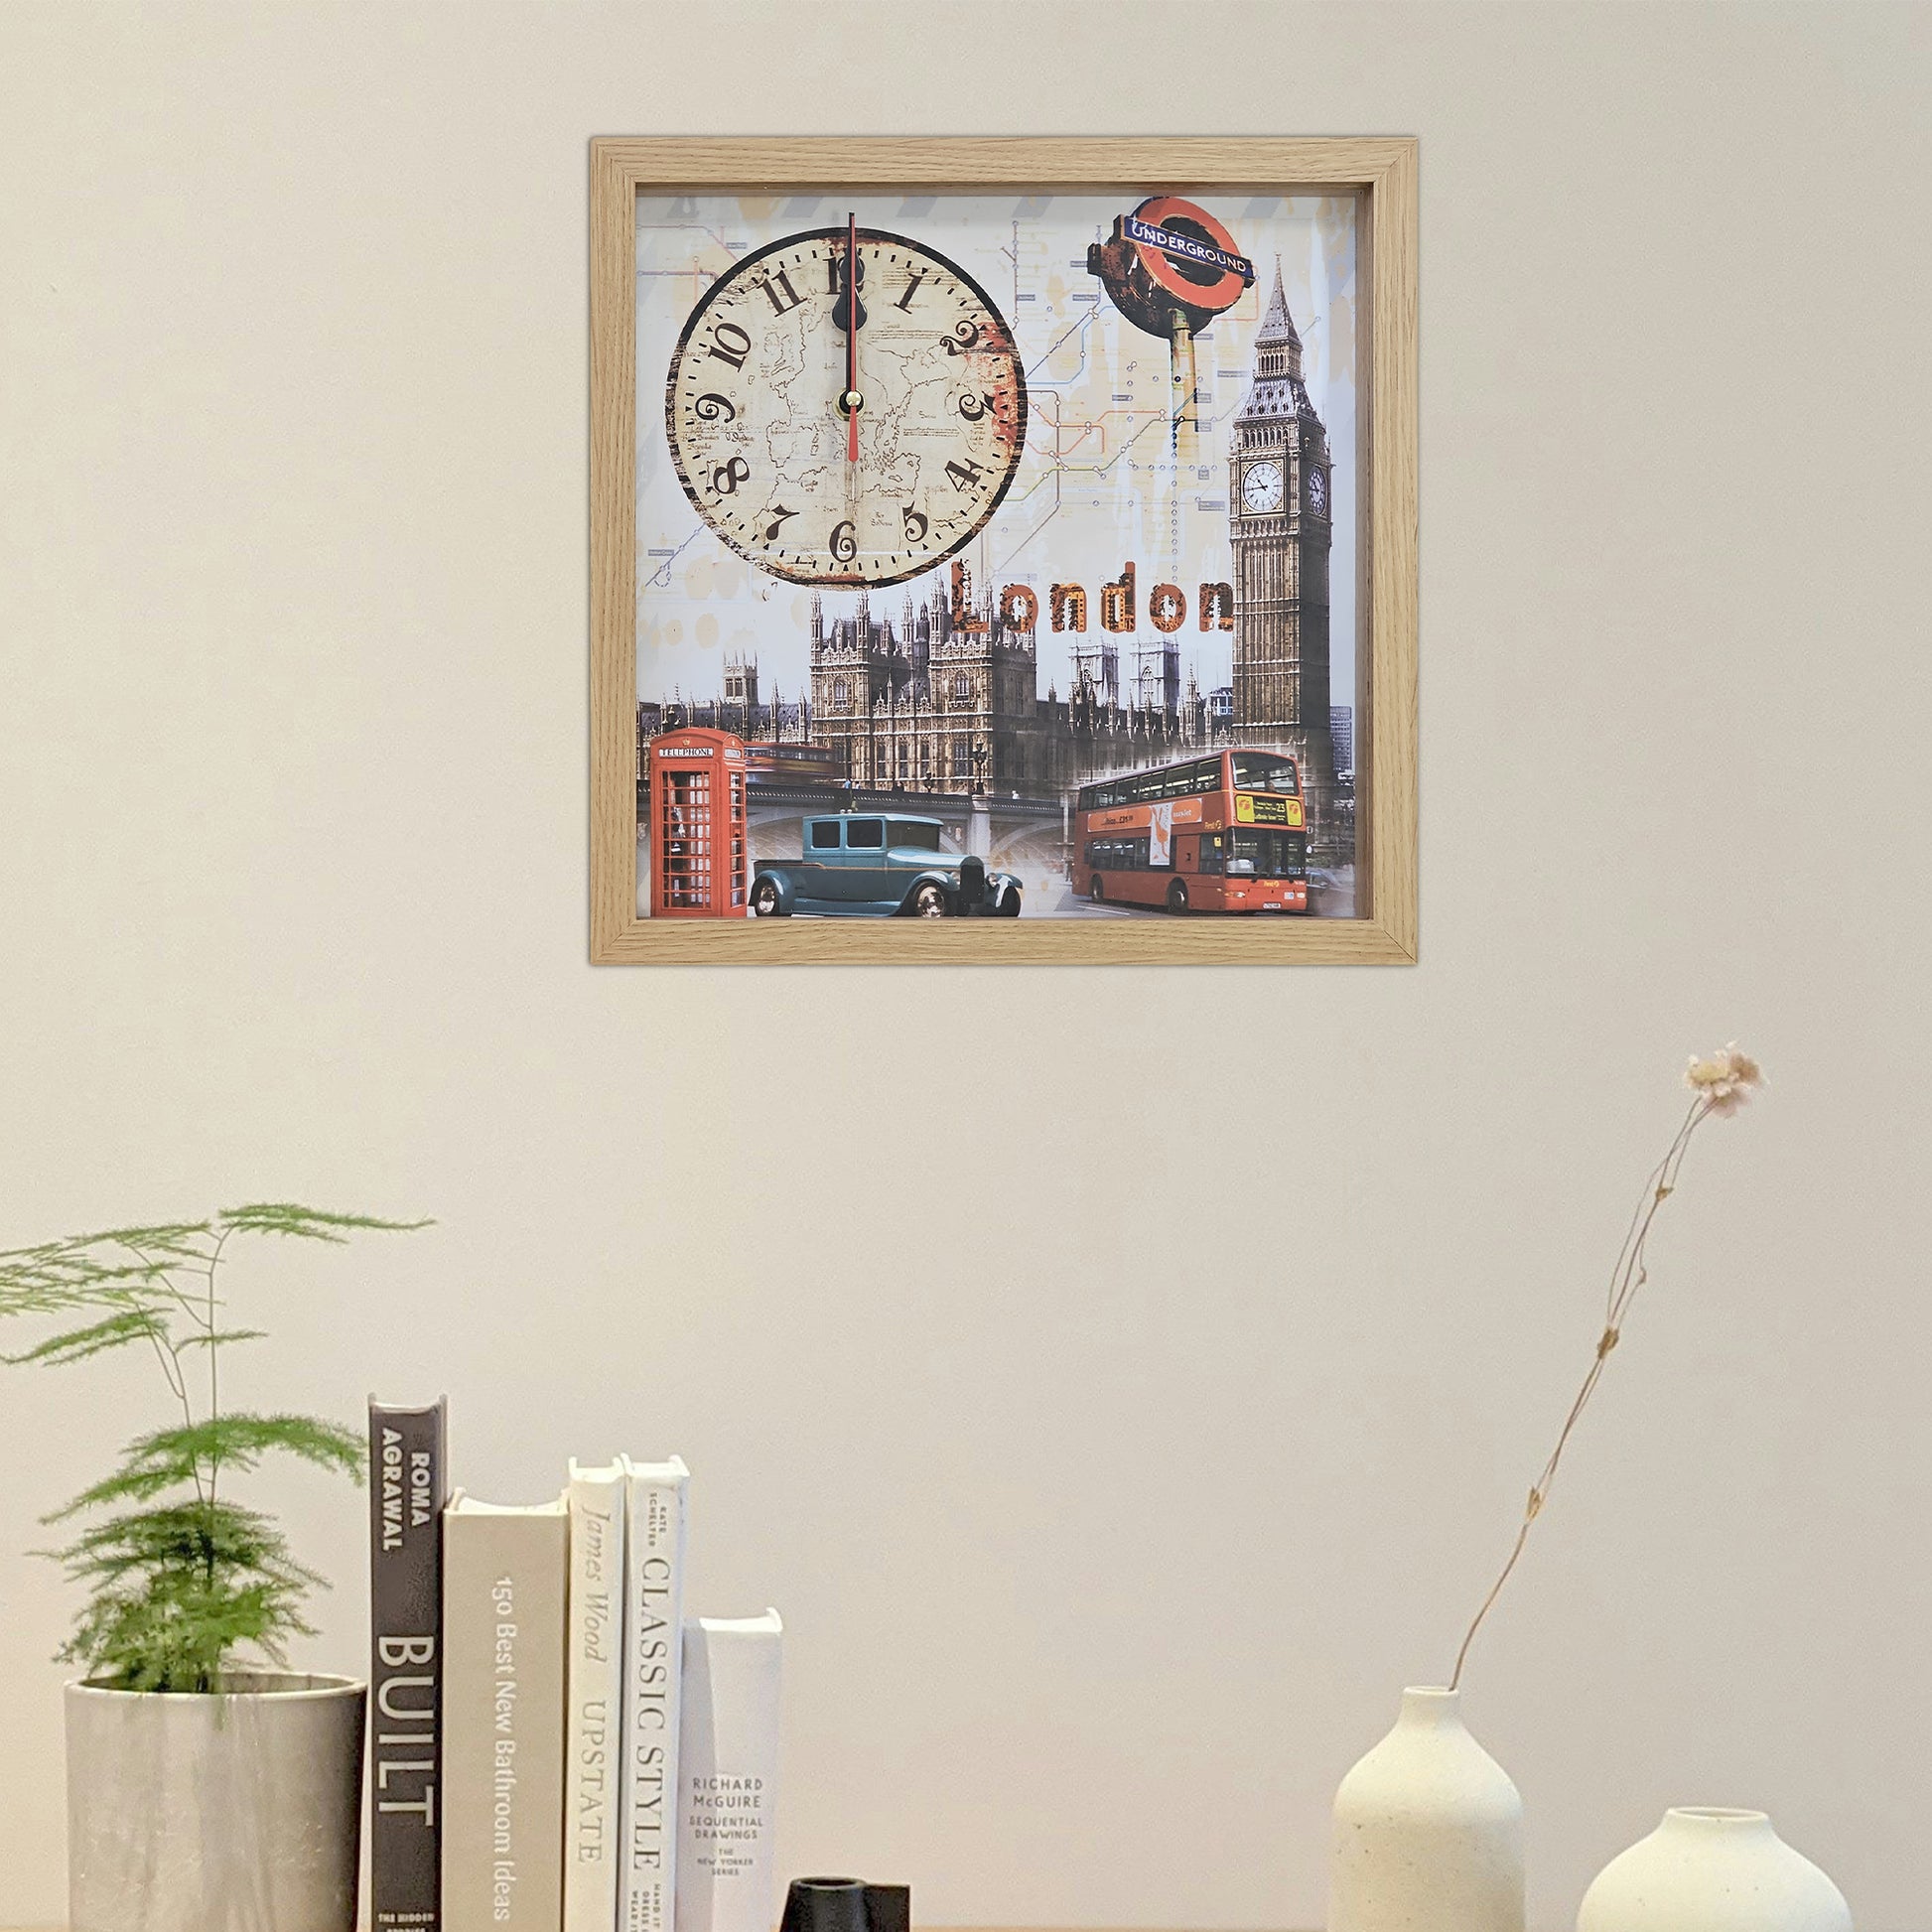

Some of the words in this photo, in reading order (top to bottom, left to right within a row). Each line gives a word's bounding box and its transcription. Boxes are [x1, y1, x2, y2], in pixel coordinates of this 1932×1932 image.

[1132, 220, 1247, 273] UNDERGROUND
[758, 269, 808, 318] 11
[894, 273, 924, 315] 1
[707, 321, 752, 372] 10
[939, 320, 980, 356] 2
[695, 393, 736, 424] 9
[958, 392, 999, 422] 3
[713, 457, 751, 494] 8
[944, 458, 984, 492] 4
[765, 503, 800, 541] 7
[829, 520, 858, 563] 6
[902, 500, 928, 543] 5
[950, 558, 1234, 633] London
[382, 1428, 402, 1551] AGRAWAL
[411, 1452, 430, 1527] ROMA
[582, 1504, 611, 1581] James
[492, 1577, 512, 1615] 150
[496, 1624, 517, 1674] Best
[585, 1592, 609, 1663] Wood
[637, 1558, 670, 1729] CLASSIC
[495, 1681, 516, 1732] New
[378, 1636, 434, 1827] BUILT
[494, 1740, 516, 1854] Bathroom
[578, 1701, 606, 1863] UPSTATE
[693, 1777, 762, 1790] RICHARD
[694, 1795, 761, 1808] McGUIRE
[633, 1745, 664, 1870] STYLE
[689, 1816, 762, 1827] SEQUENTIAL
[695, 1829, 758, 1840] DRAWINGS
[493, 1861, 516, 1921] Ideas
